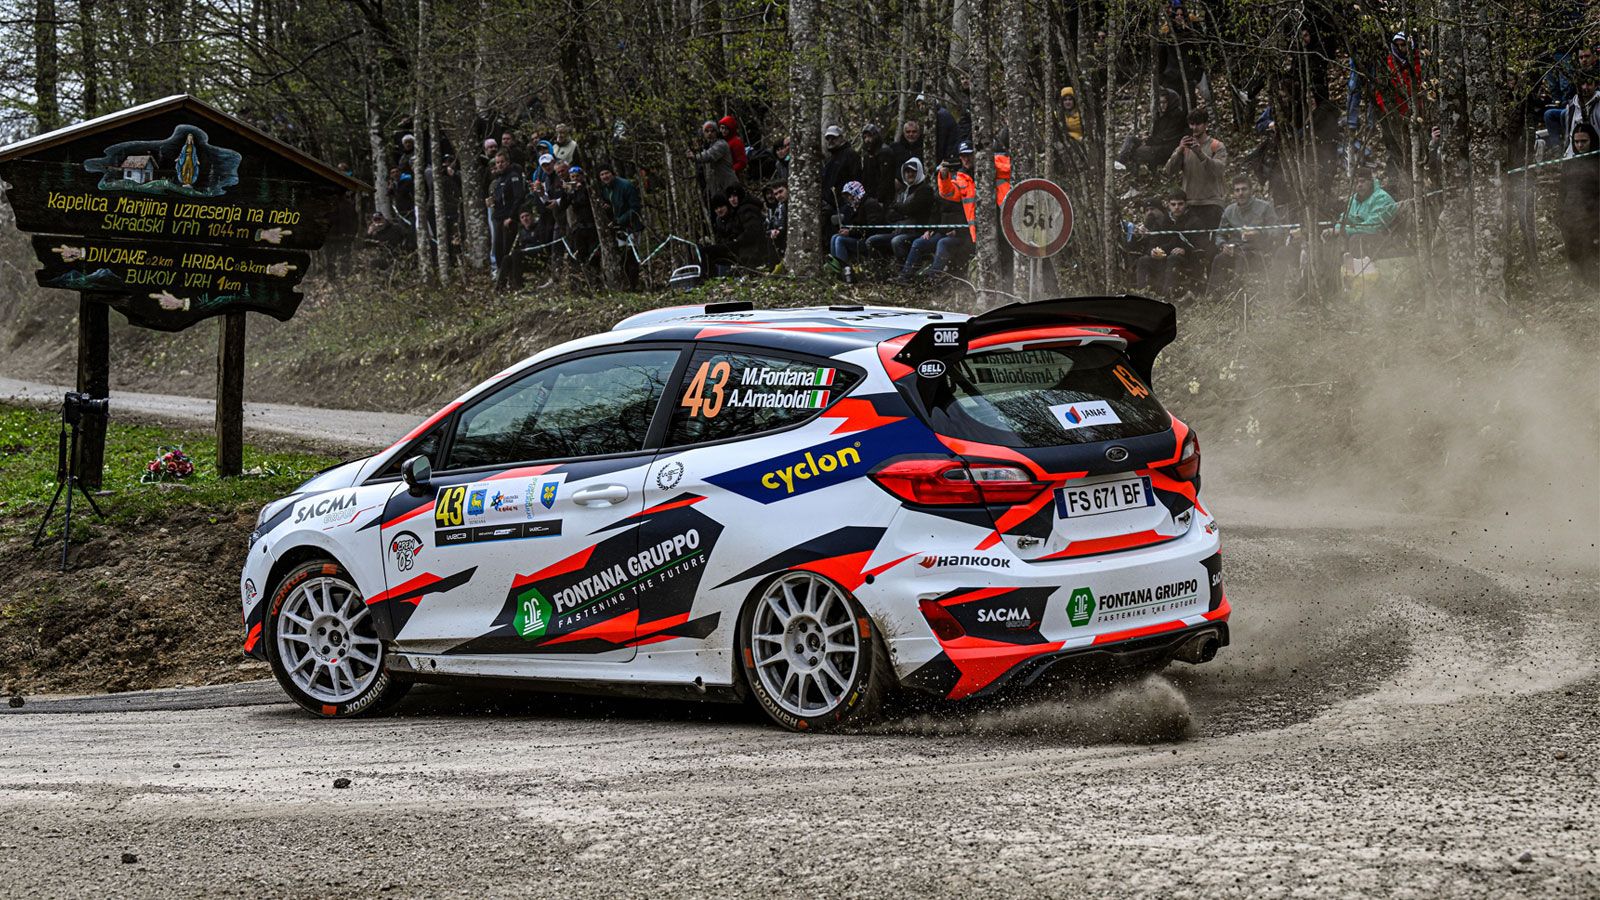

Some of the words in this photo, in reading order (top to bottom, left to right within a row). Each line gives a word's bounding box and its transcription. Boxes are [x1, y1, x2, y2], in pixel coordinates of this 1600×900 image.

[48, 192, 108, 213] Kapelica
[114, 197, 168, 217] Marijina
[174, 203, 241, 223] uznesenja
[247, 208, 264, 222] na
[269, 208, 300, 224] nebo
[101, 214, 166, 233] Skradski
[208, 222, 234, 237] 1044
[87, 247, 147, 265] DIVJAKE
[181, 253, 235, 271] HRIBAC
[125, 268, 177, 285] BUKOV
[184, 272, 212, 288] VRH
[934, 331, 959, 343] OMP
[741, 367, 815, 386] M.Fontana
[921, 364, 942, 373] BELL
[681, 361, 731, 418] 43
[1112, 365, 1149, 399] 43
[1081, 408, 1107, 419] JANAF
[761, 446, 861, 493] cyclon
[295, 492, 357, 524] SACMA
[436, 486, 466, 526] 43
[1068, 491, 1091, 511] FS
[1093, 486, 1118, 509] 671
[1121, 483, 1141, 505] BF
[553, 564, 628, 613] FONTANA
[627, 529, 700, 577] GRUPPO
[558, 593, 626, 628] FASTENING
[632, 578, 653, 595] THE
[660, 554, 706, 582] FUTURE
[1099, 588, 1152, 610] FONTANA
[1155, 579, 1197, 600] GRUPPO
[977, 607, 1031, 622] SACMA
[1098, 609, 1146, 622] FASTENING
[1170, 598, 1197, 610] FUTURE
